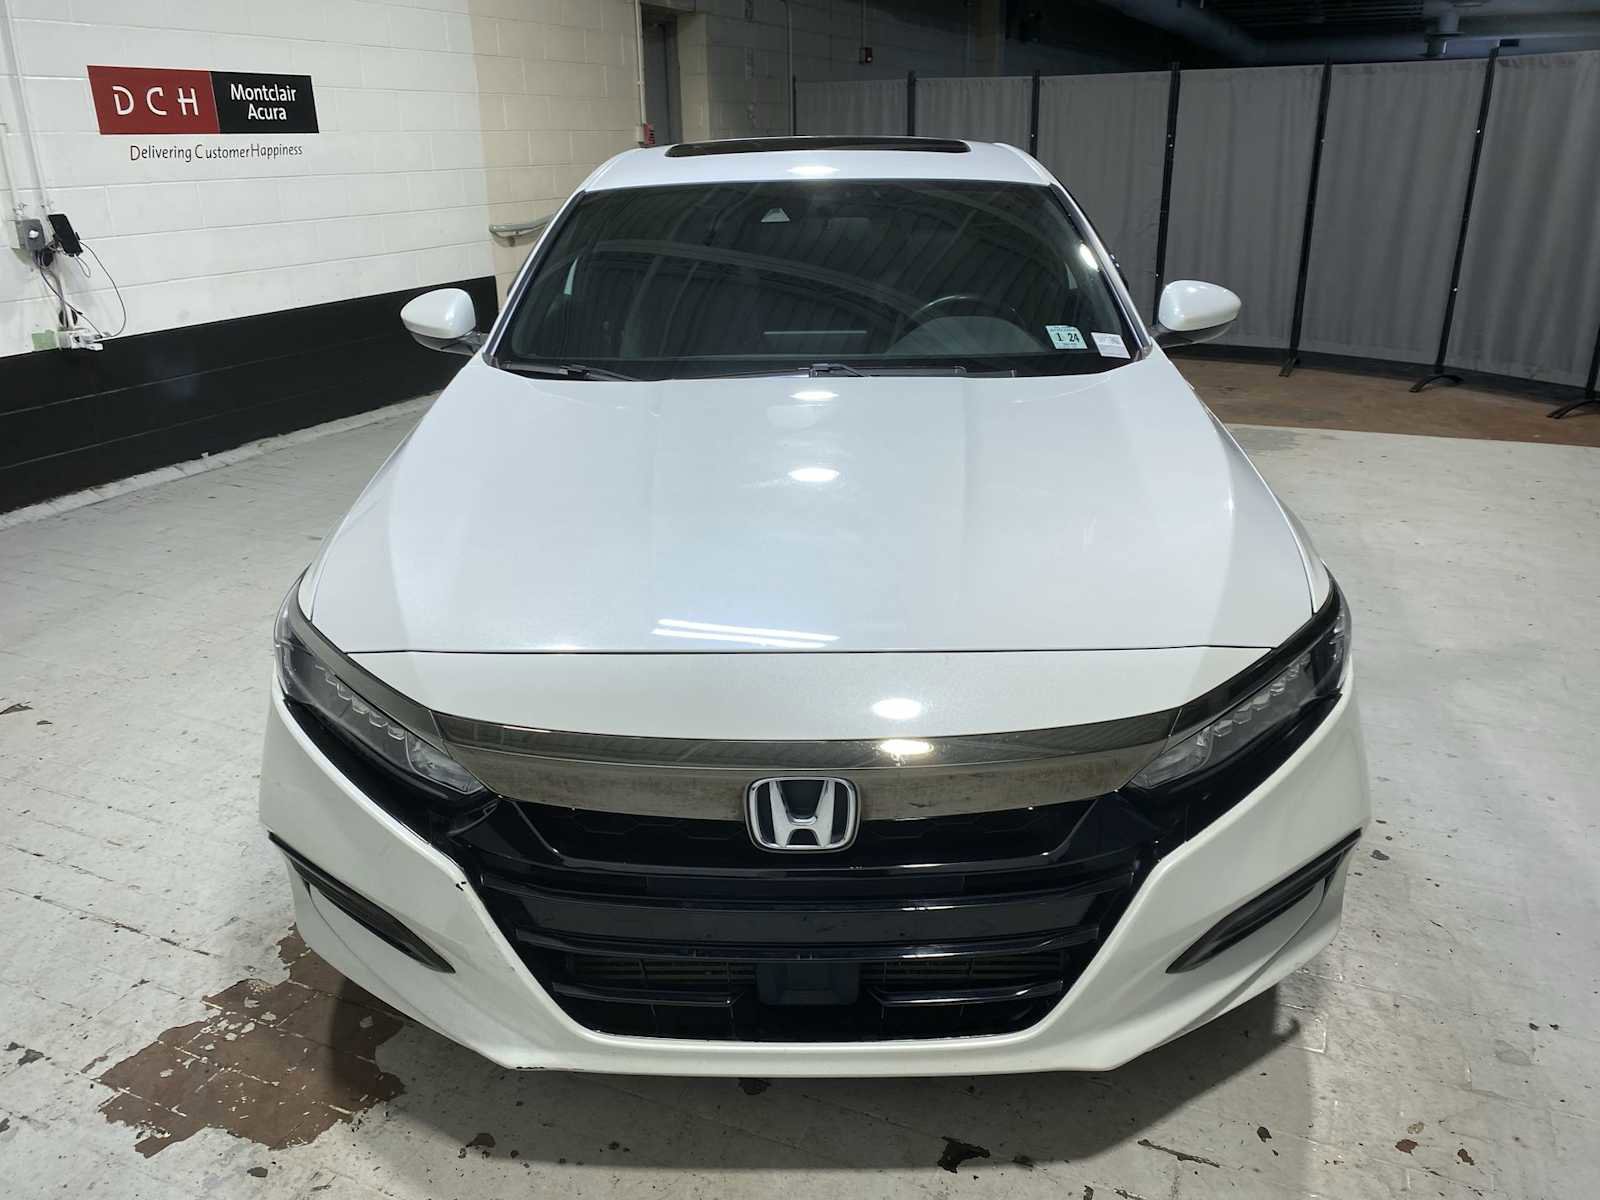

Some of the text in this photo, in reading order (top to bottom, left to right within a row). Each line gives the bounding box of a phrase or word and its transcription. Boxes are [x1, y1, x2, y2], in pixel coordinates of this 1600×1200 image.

[112, 85, 199, 116] DCH
[230, 83, 297, 102] Montclair
[247, 103, 288, 121] Acura
[130, 145, 192, 163] Delivering
